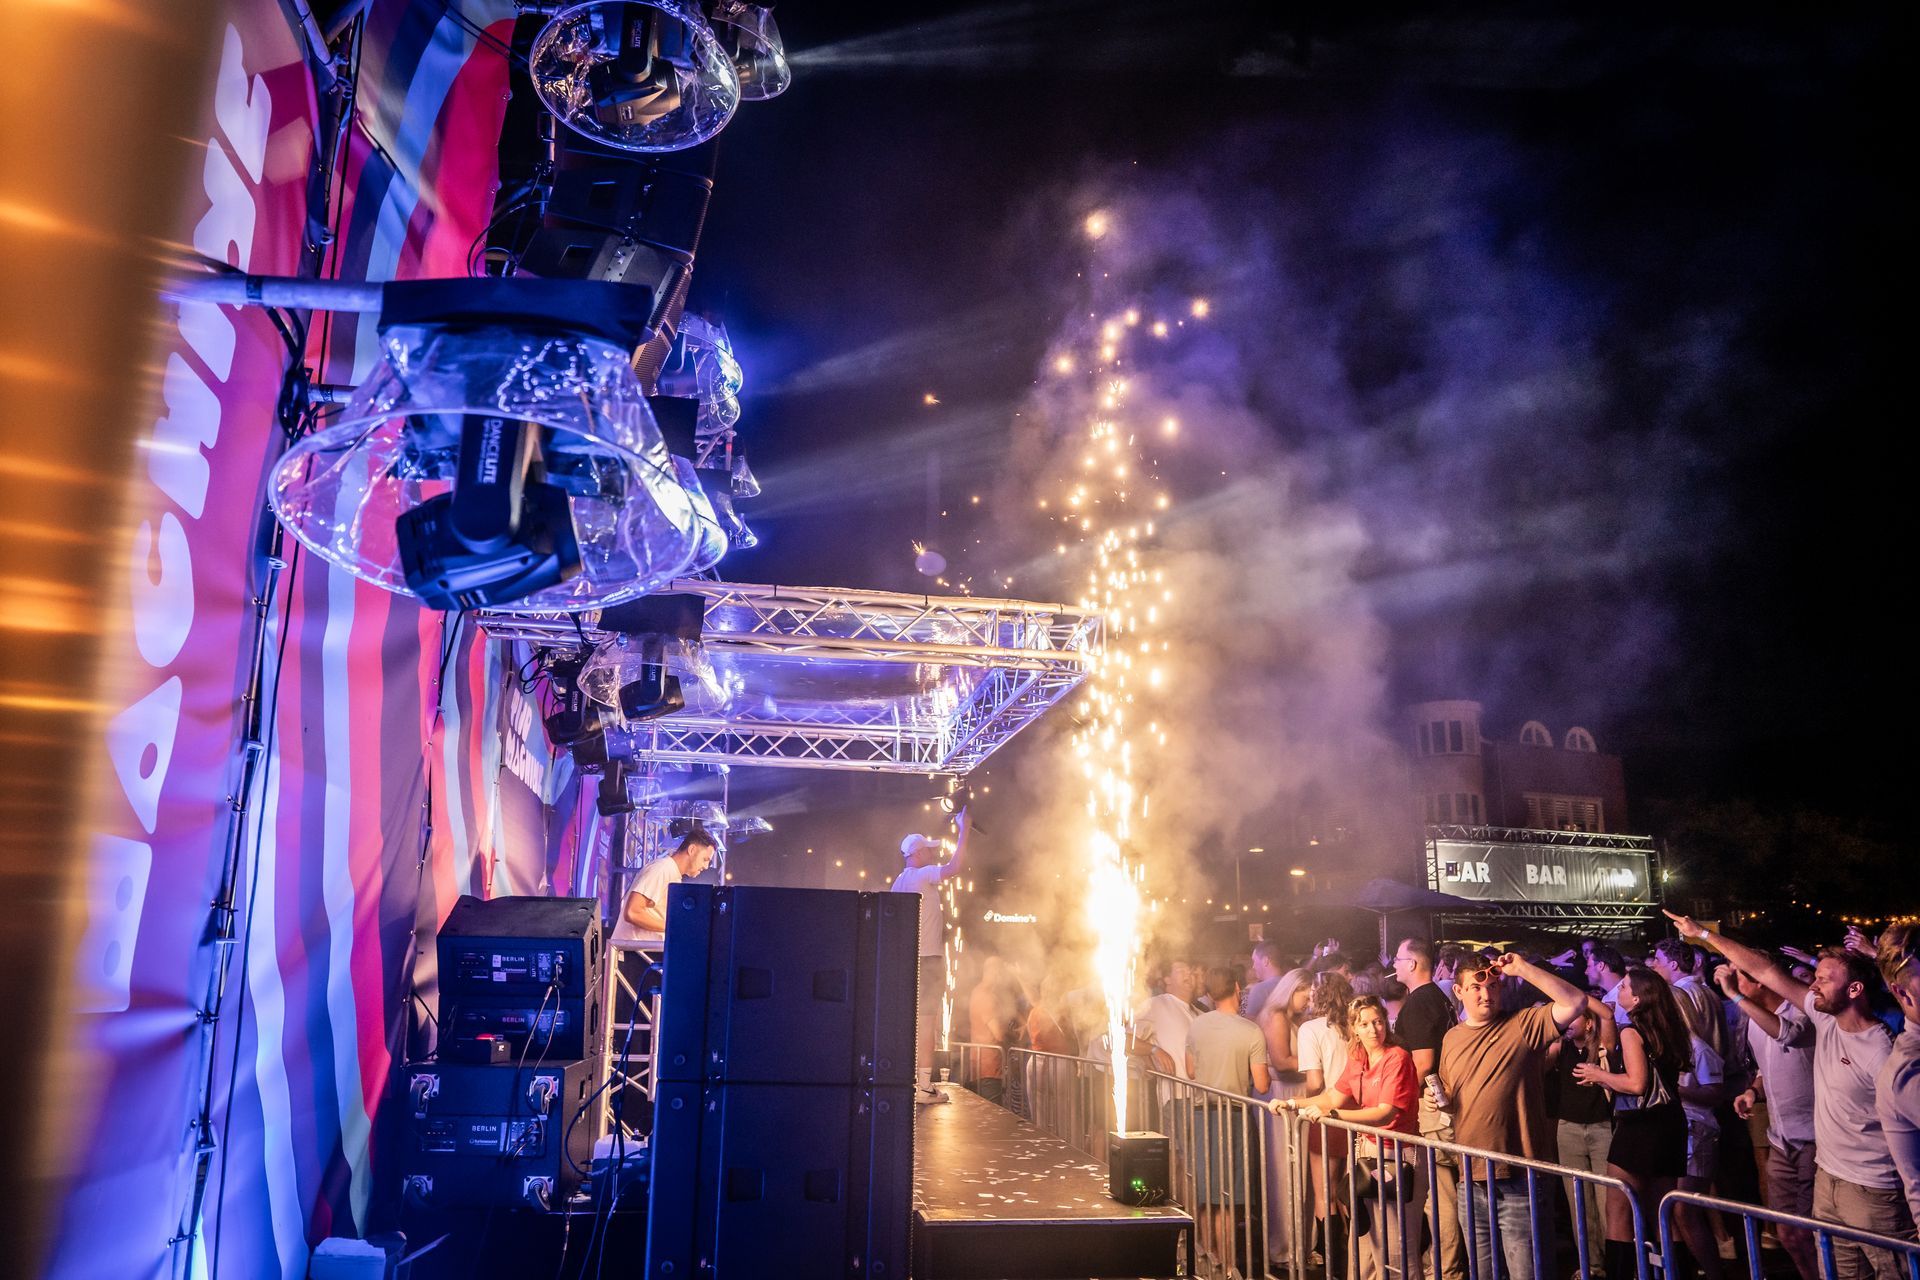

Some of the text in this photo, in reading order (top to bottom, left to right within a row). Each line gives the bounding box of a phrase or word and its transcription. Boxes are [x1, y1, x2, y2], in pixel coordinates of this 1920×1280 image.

[483, 418, 503, 484] DANCELITE
[505, 727, 545, 800] MACHINE
[1526, 864, 1567, 886] BAR
[994, 913, 1036, 923] Domino's
